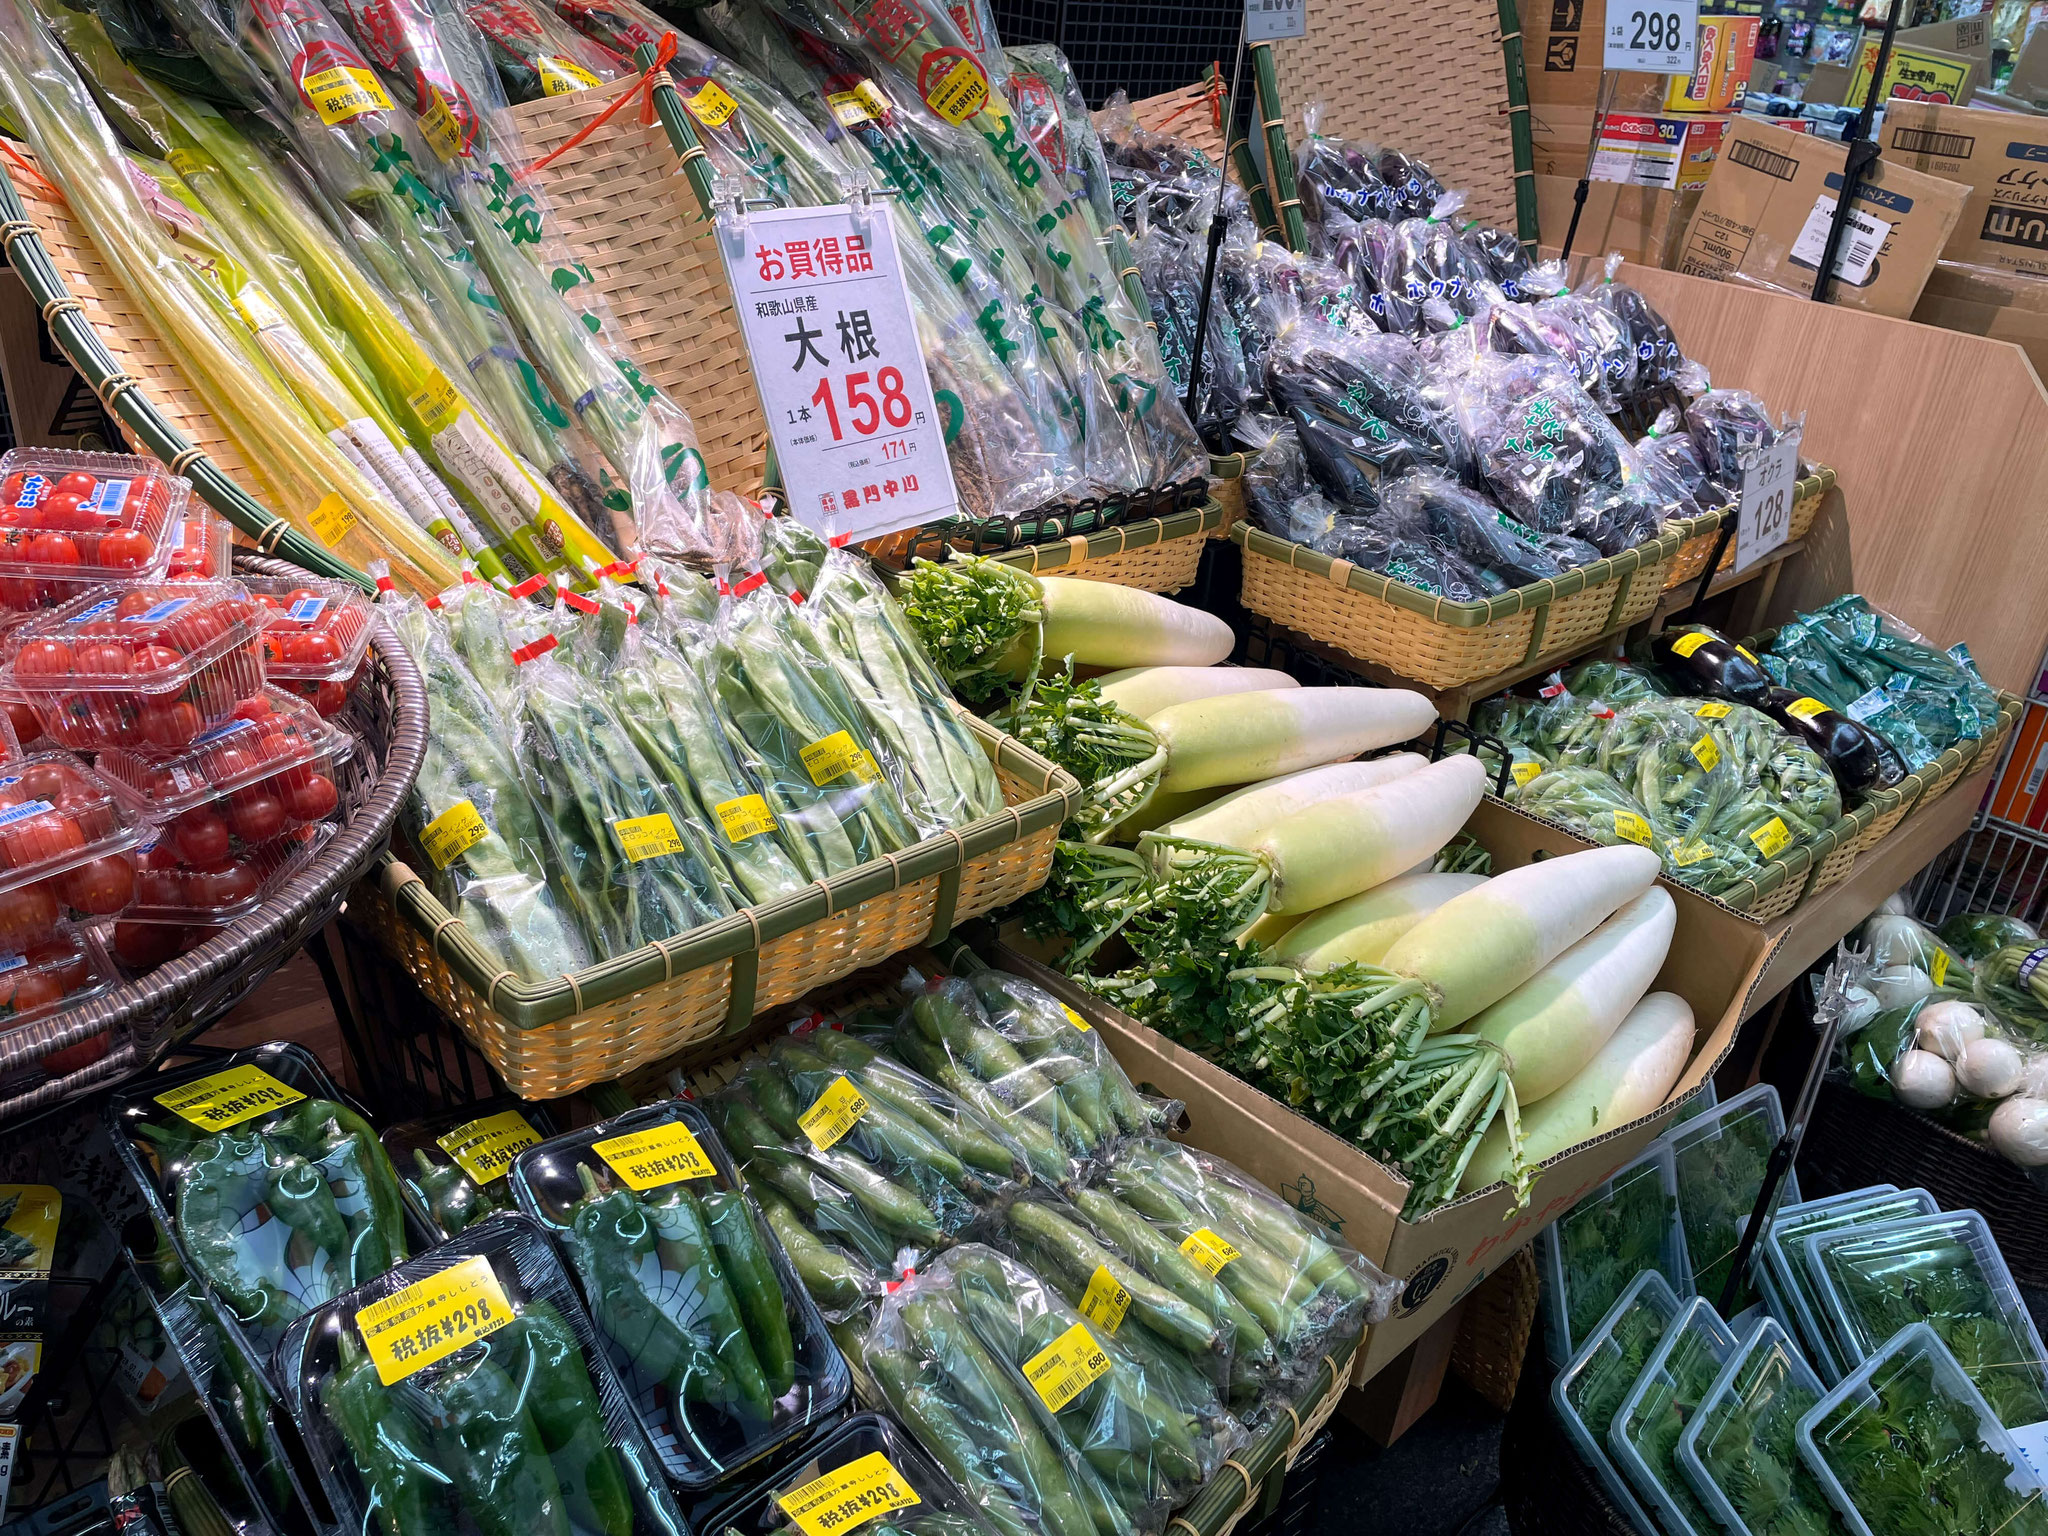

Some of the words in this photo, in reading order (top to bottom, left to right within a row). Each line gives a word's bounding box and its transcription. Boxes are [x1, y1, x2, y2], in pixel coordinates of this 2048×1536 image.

[1630, 11, 1681, 51] 298
[948, 80, 984, 119] 税抜¥398
[1658, 124, 1674, 139] 30
[755, 235, 874, 282] お買得品
[1702, 240, 1733, 259] 900mL
[755, 296, 819, 318] 和歌山県産
[784, 309, 880, 373] 大根
[786, 406, 812, 424] 1本
[811, 366, 912, 442] 158
[914, 411, 926, 425] 円
[881, 439, 908, 460] 171
[909, 442, 918, 452] 円
[341, 512, 354, 525] 198
[1754, 489, 1784, 541] 128
[849, 751, 863, 763] 298
[468, 822, 486, 837] 298
[622, 827, 673, 842] モロッコインゲン
[667, 839, 682, 848] 298
[202, 1087, 285, 1122] 税抜¥298
[850, 1097, 866, 1114] 680
[629, 1151, 700, 1180] 税抜¥298
[1114, 1288, 1127, 1307] 680
[390, 1298, 491, 1362] 税抜¥298
[1087, 1351, 1107, 1371] 680
[817, 1482, 901, 1530] 税抜¥298
